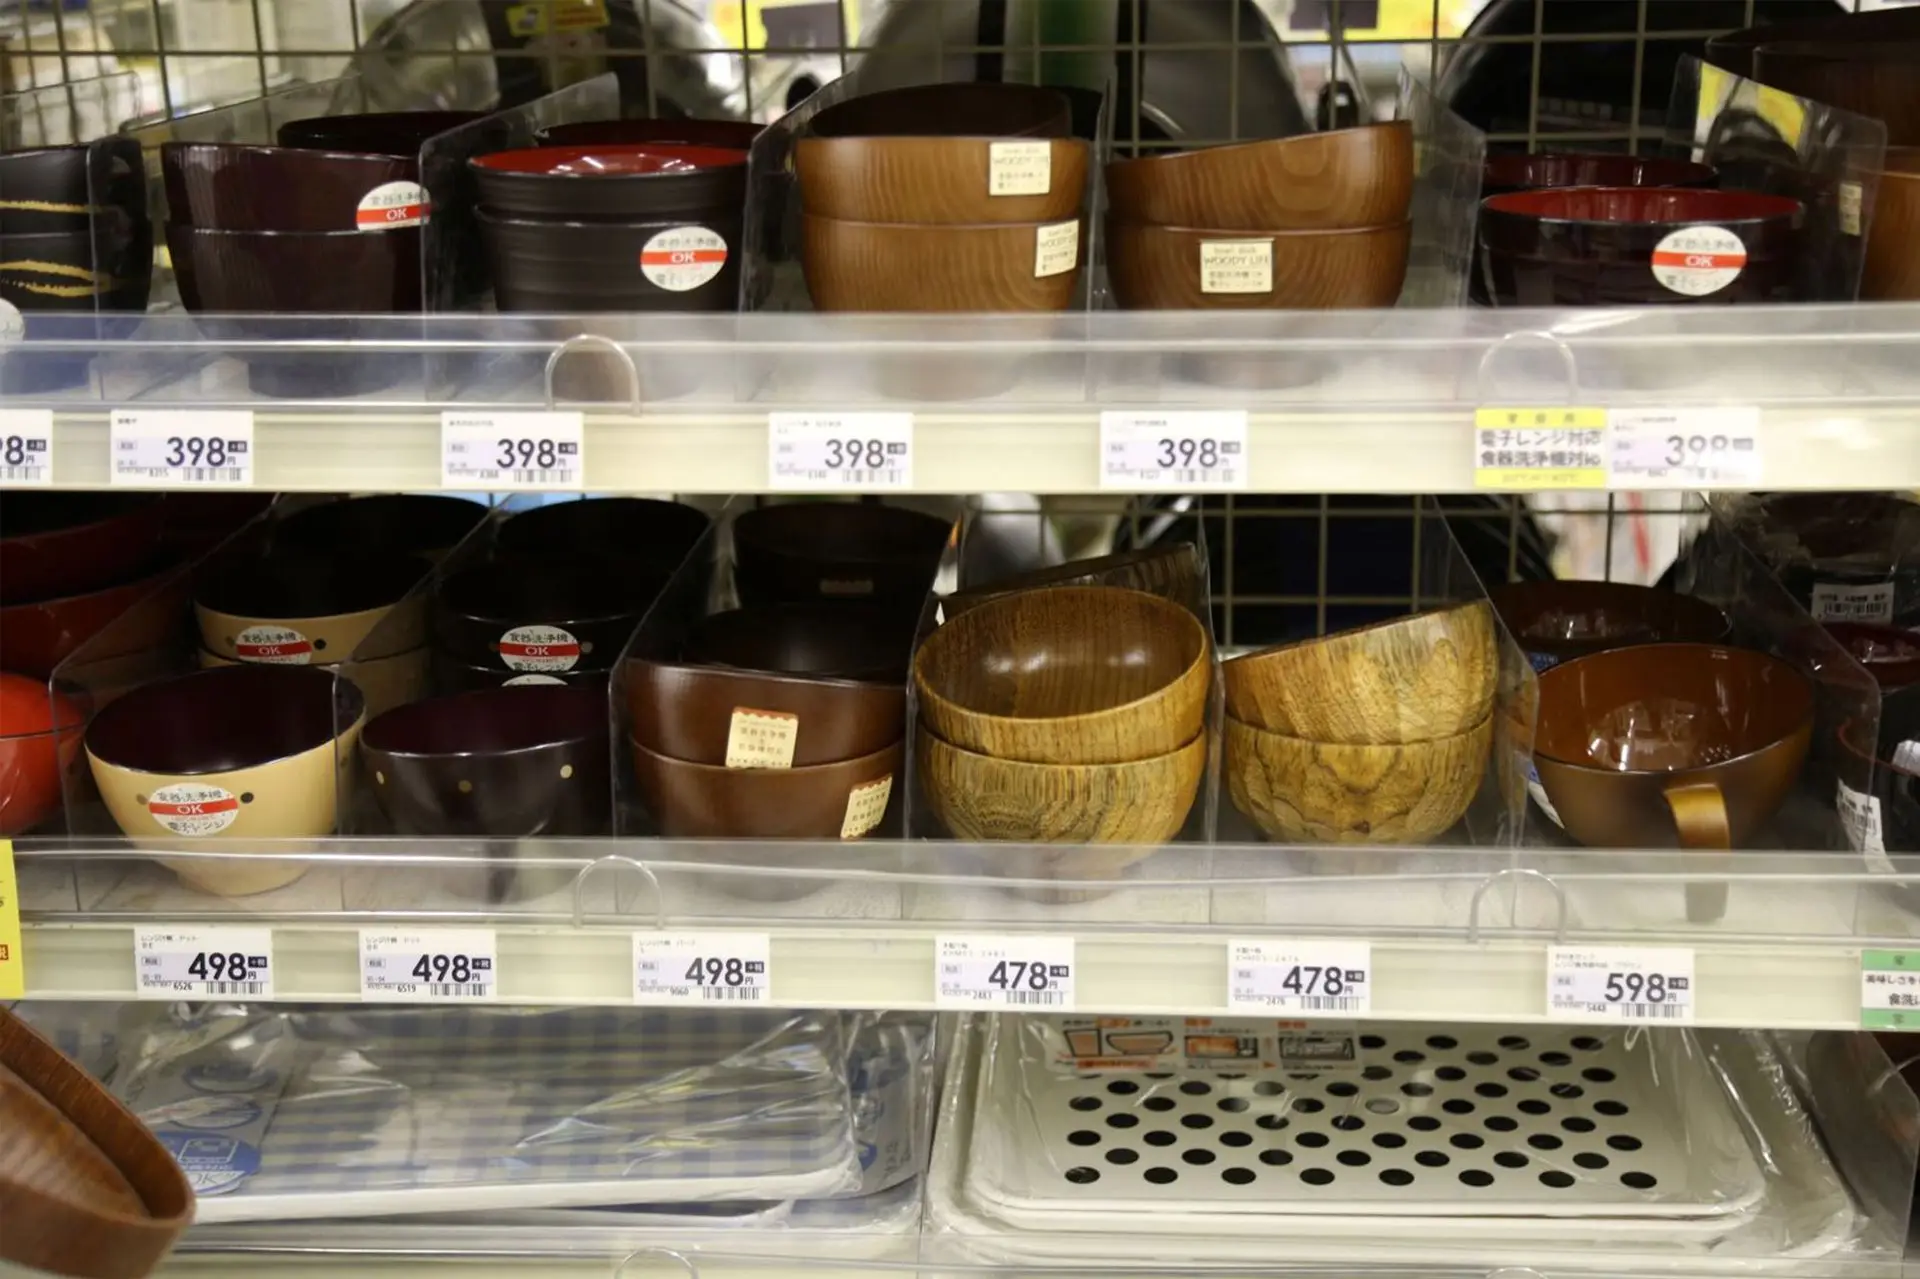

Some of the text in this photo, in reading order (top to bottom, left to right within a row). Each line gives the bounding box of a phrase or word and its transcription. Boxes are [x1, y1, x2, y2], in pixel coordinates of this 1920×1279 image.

[386, 207, 407, 221] OK
[671, 251, 695, 264] OK
[1684, 254, 1713, 267] OK
[165, 436, 226, 467] 398
[497, 438, 556, 469] 398
[825, 439, 885, 469] 398
[1157, 438, 1218, 469] 398
[258, 646, 281, 656] OK
[525, 646, 550, 656] OK
[176, 804, 204, 816] OK
[188, 952, 247, 981] 498
[412, 954, 471, 983] 498
[685, 957, 744, 986] 498
[988, 961, 1048, 990] 478
[1282, 966, 1343, 995] 478
[1866, 973, 1920, 986] 美味しさを
[173, 982, 193, 991] 6526
[397, 983, 417, 993] 6519
[1604, 972, 1666, 1003] 598
